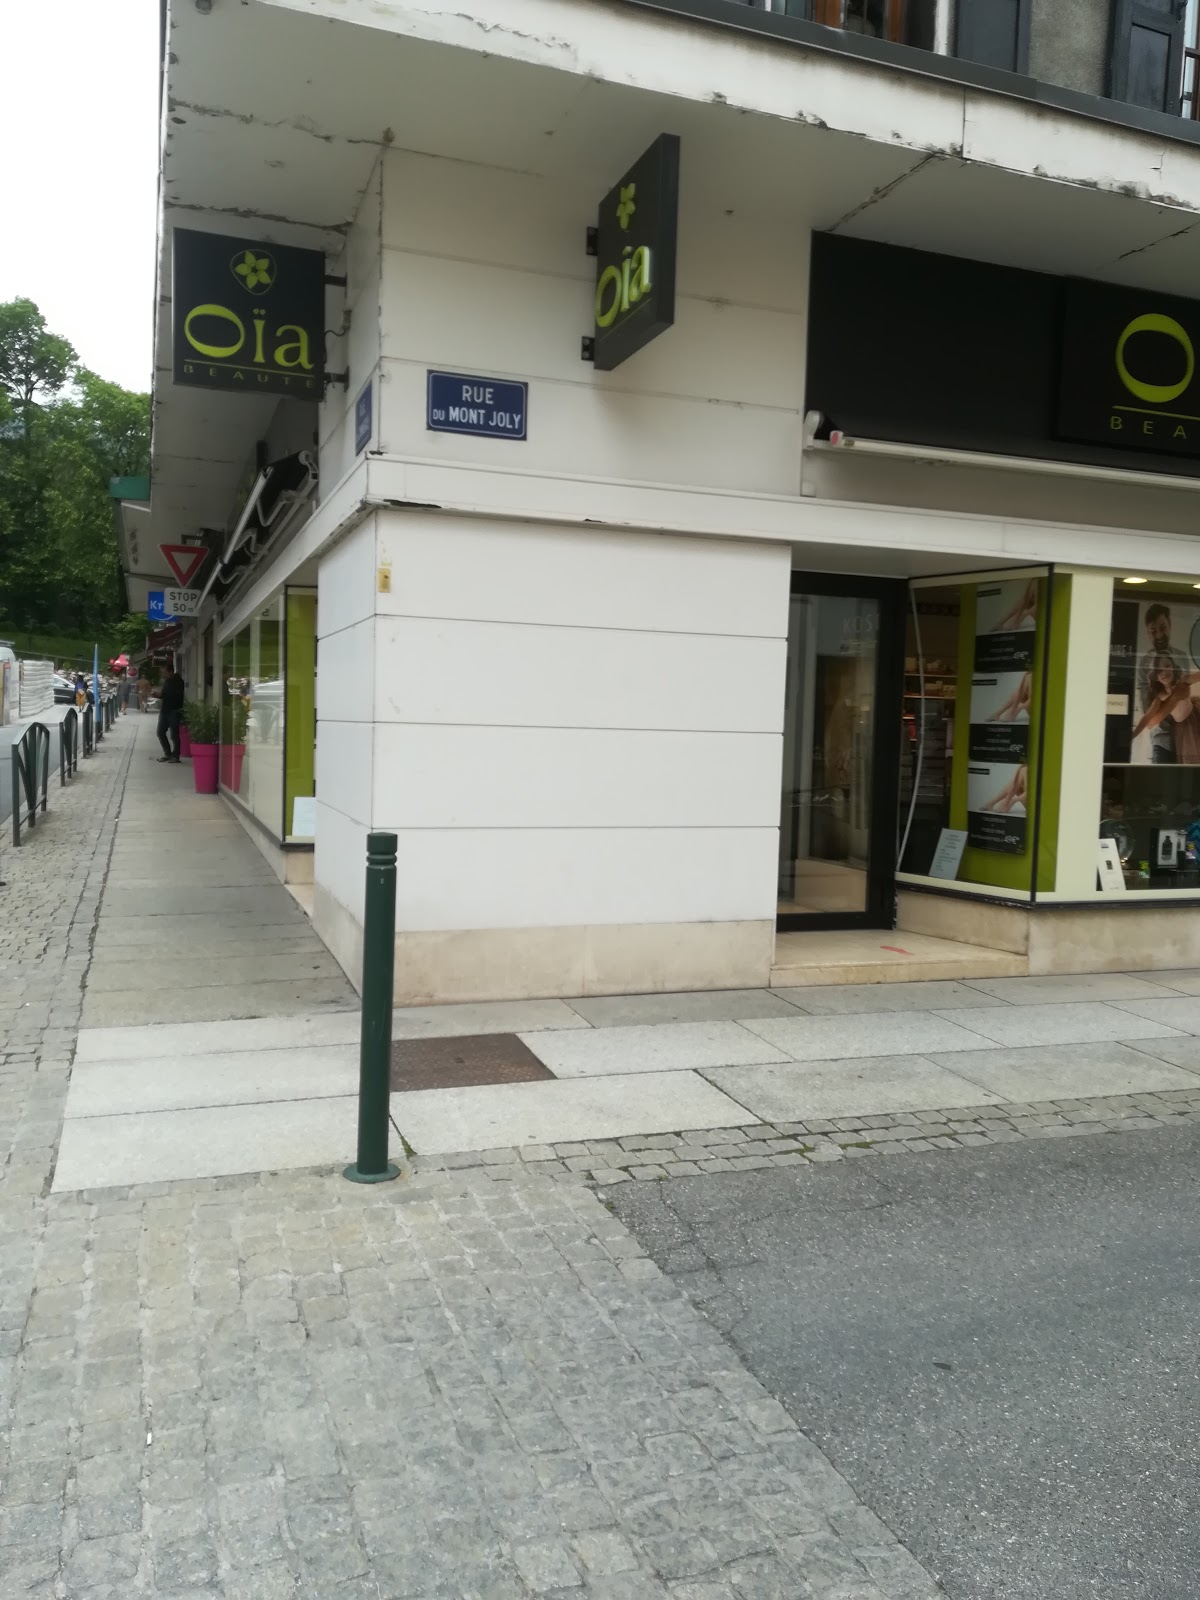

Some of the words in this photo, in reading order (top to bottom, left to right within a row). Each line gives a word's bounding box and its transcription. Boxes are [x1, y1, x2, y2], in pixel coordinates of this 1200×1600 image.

[184, 303, 315, 370] Oïa
[462, 385, 494, 405] RUE
[432, 408, 445, 421] DU
[449, 406, 486, 426] MONT
[489, 411, 522, 430] JOLY
[150, 600, 165, 610] Kr
[169, 592, 197, 602] STOP
